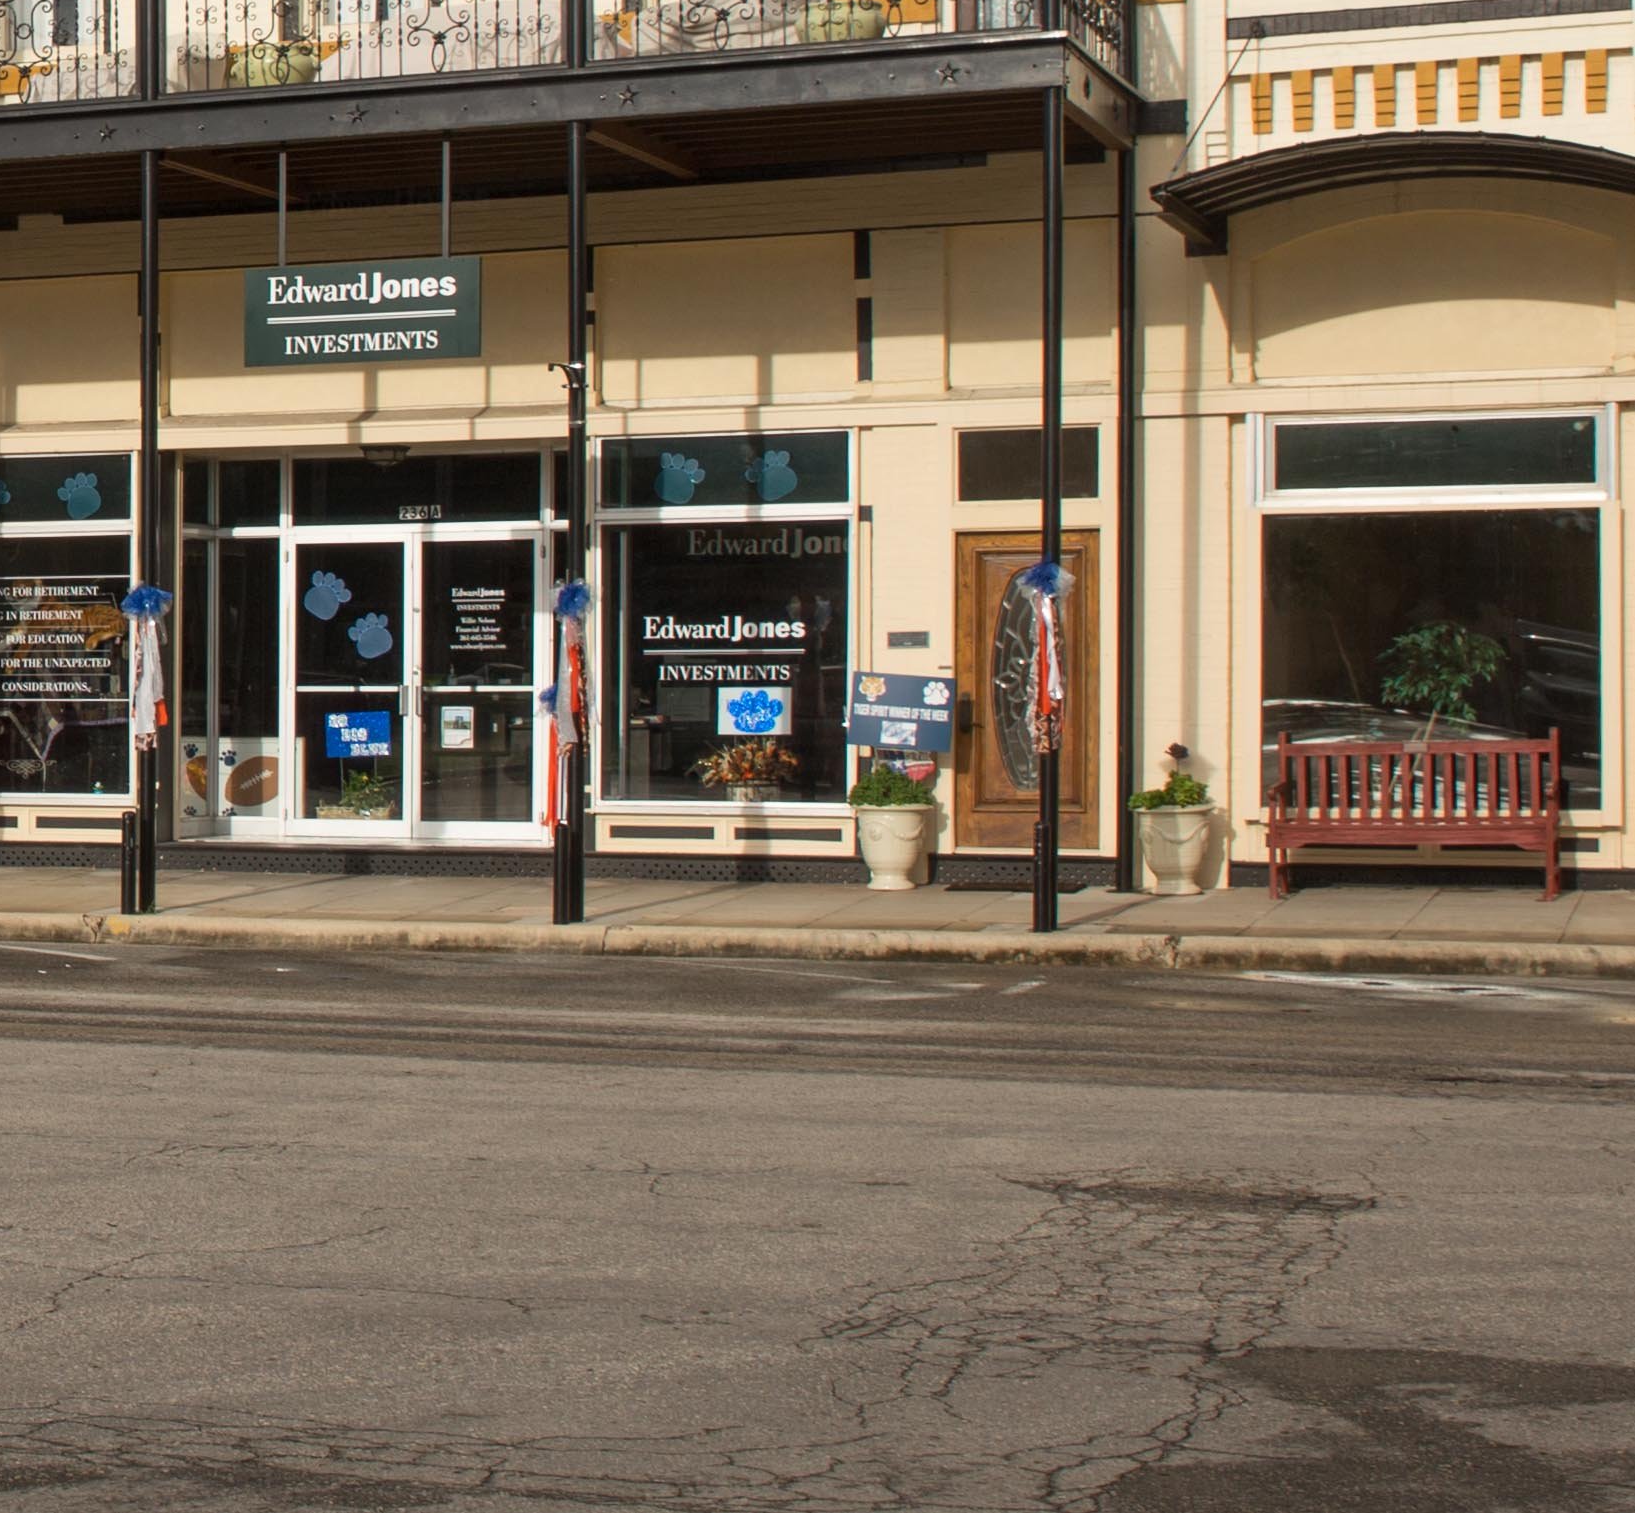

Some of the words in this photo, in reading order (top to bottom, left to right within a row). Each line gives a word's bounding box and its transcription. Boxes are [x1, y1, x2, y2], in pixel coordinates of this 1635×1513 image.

[284, 329, 439, 355] INVESTMENTS
[12, 586, 32, 597] FOR
[34, 585, 99, 597] RETIREMENT
[6, 610, 18, 621] IN
[19, 610, 83, 620] RETIREMENT
[6, 634, 26, 645] FOR
[28, 633, 84, 644] EDUCATION
[0, 657, 21, 668] FOR
[22, 657, 43, 668] THE
[44, 657, 111, 668] UNEXPECTED
[659, 664, 791, 681] INVESTMENTS
